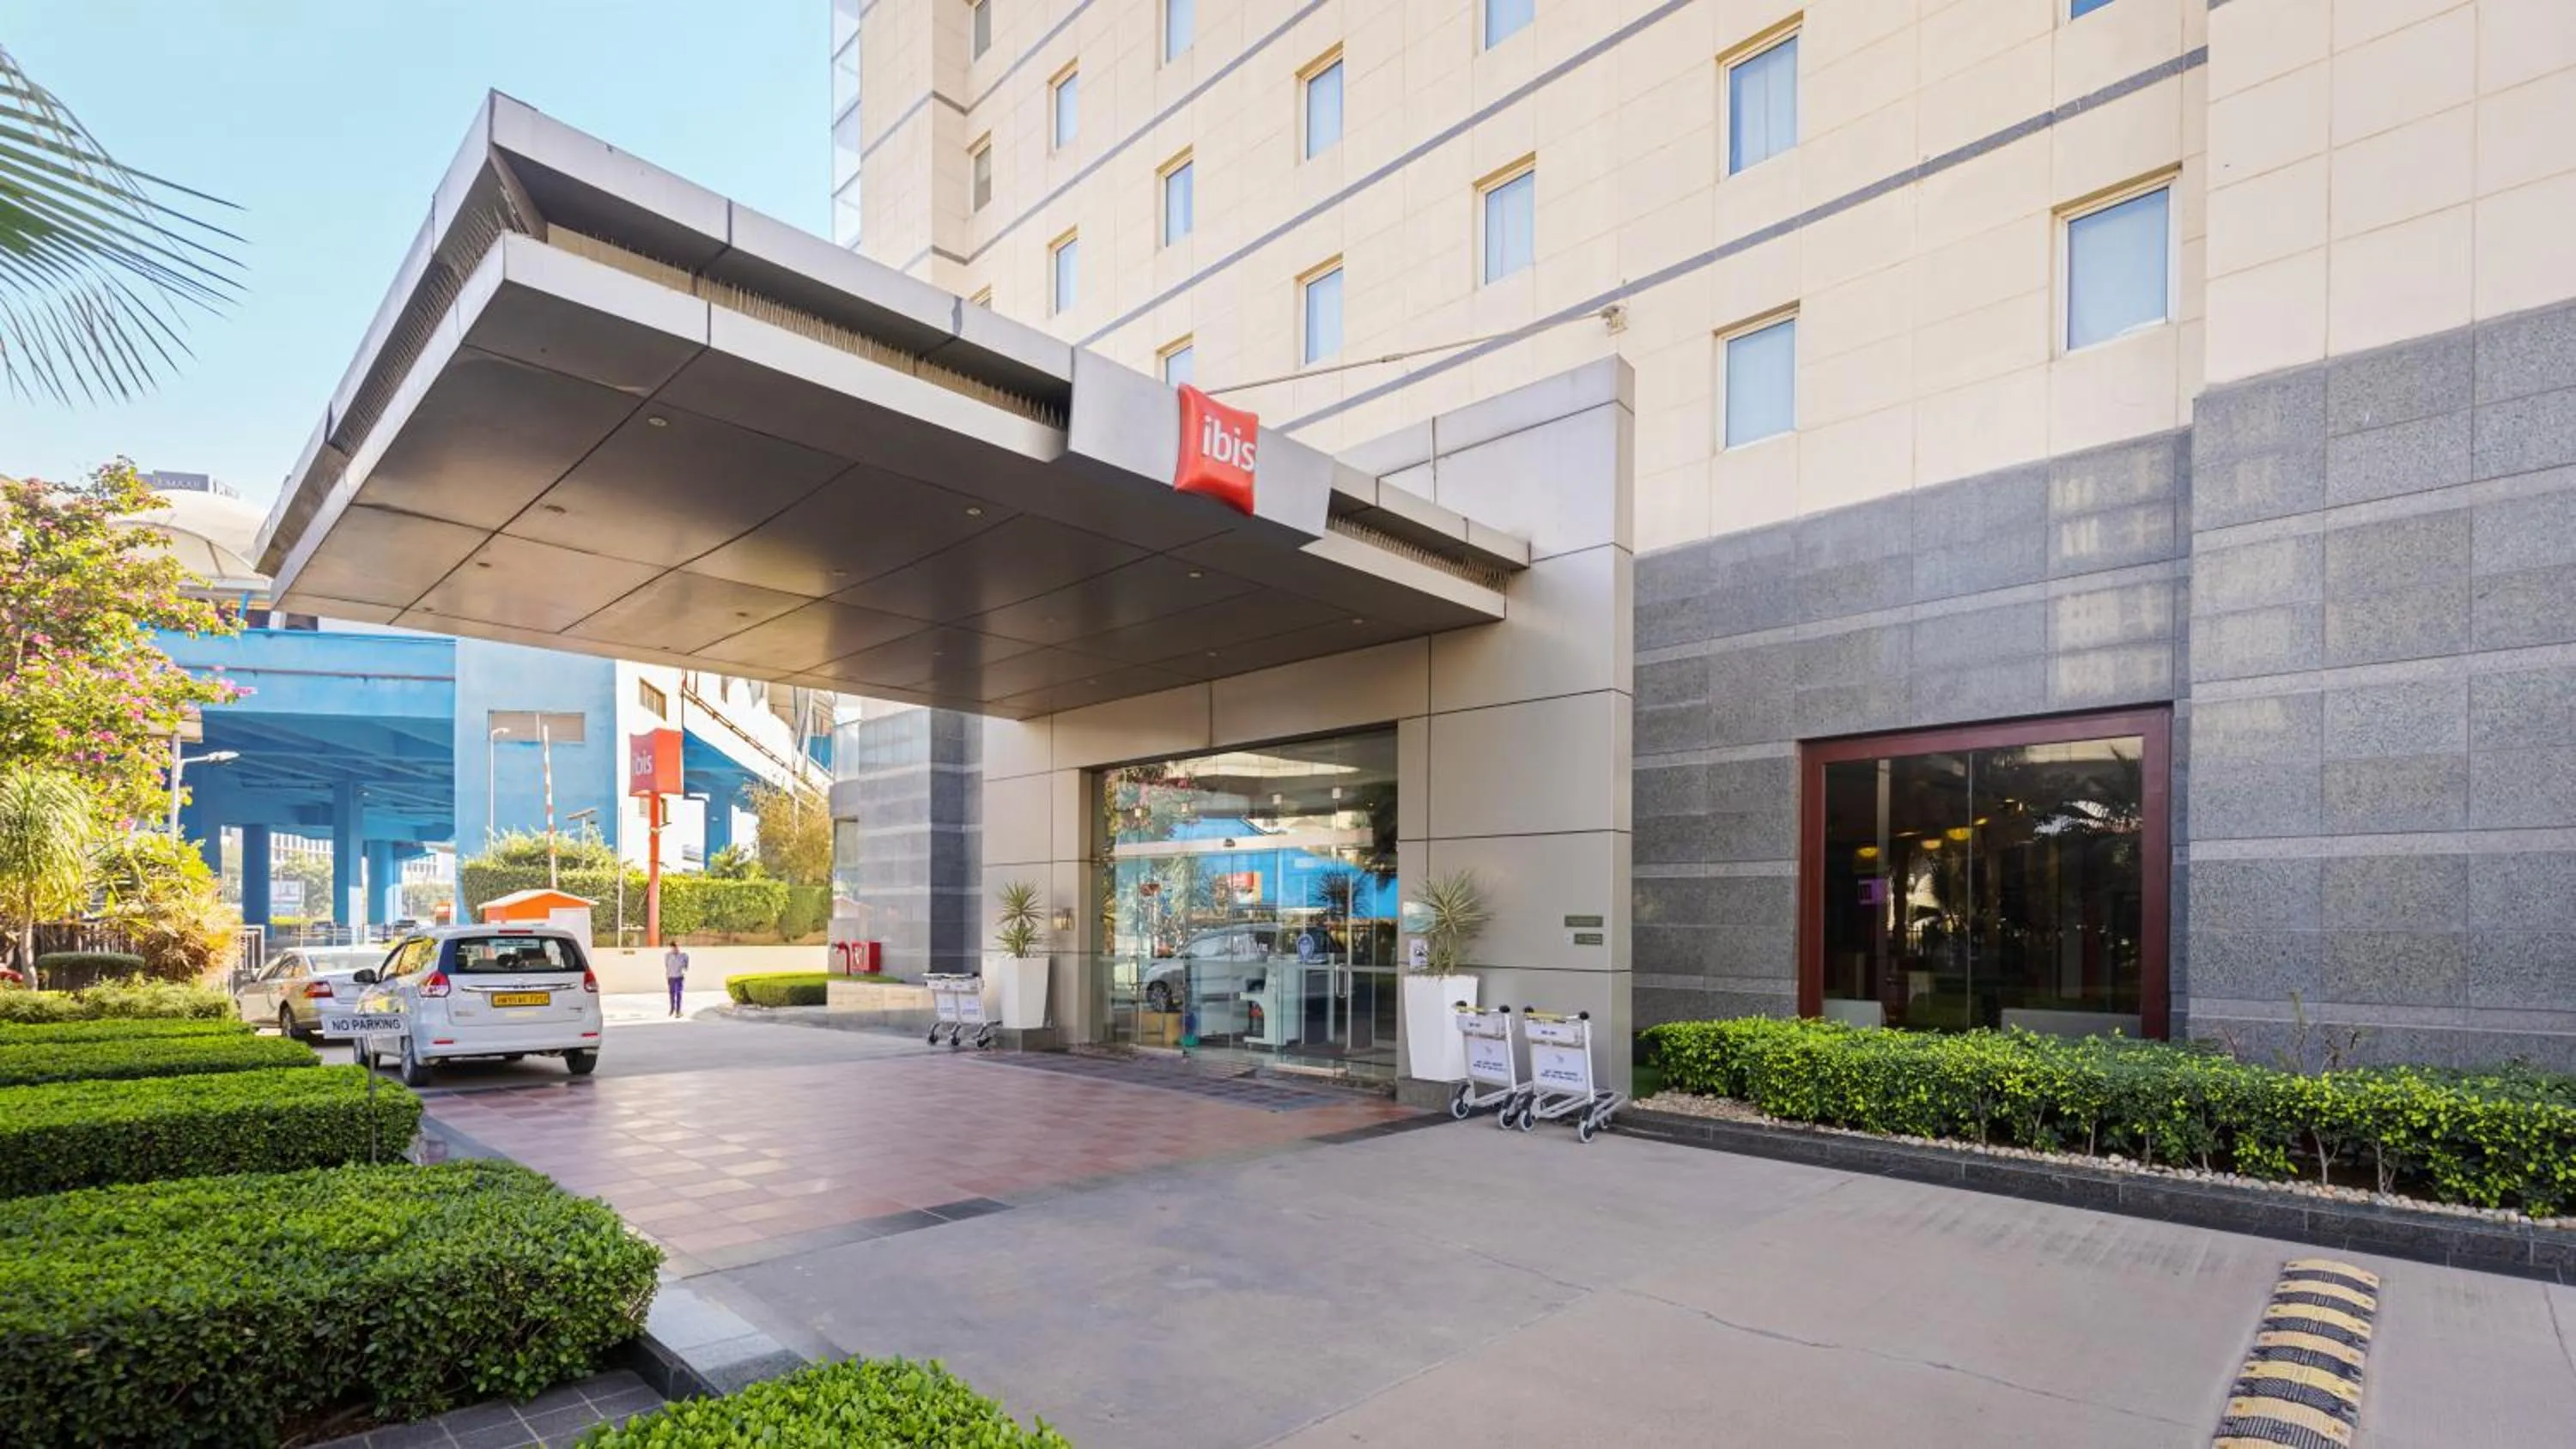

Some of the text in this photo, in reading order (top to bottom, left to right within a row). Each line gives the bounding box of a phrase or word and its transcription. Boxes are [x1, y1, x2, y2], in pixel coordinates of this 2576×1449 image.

[1202, 414, 1257, 472] ibis
[331, 1018, 401, 1031] NO PARKING
